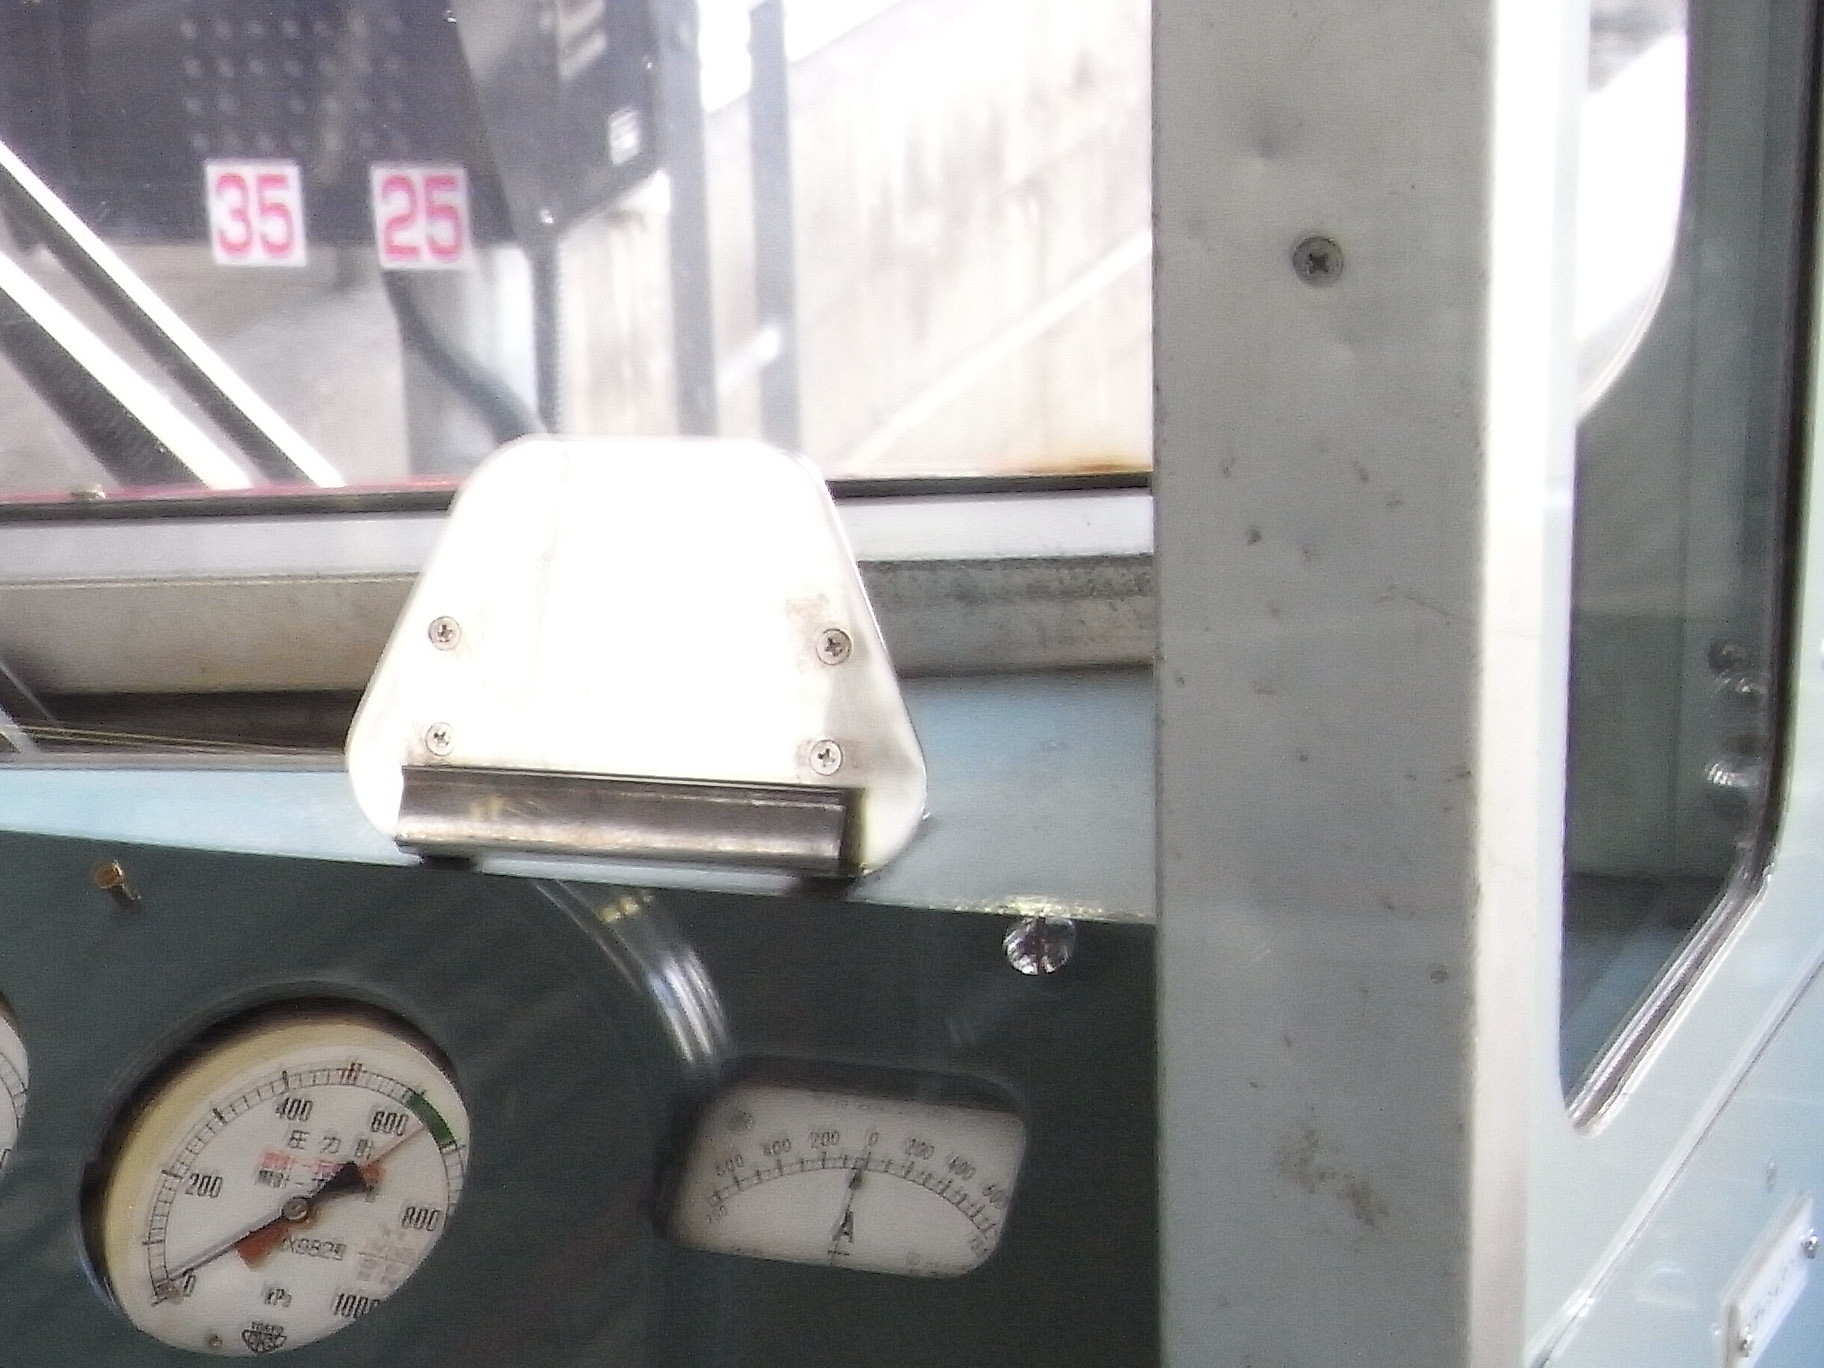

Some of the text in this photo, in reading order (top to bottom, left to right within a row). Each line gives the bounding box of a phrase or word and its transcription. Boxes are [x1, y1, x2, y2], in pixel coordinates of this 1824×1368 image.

[216, 172, 295, 258] 35
[382, 174, 463, 260] 25
[276, 1096, 313, 1122] 400
[371, 1106, 409, 1136] 600
[185, 1173, 222, 1199] 200
